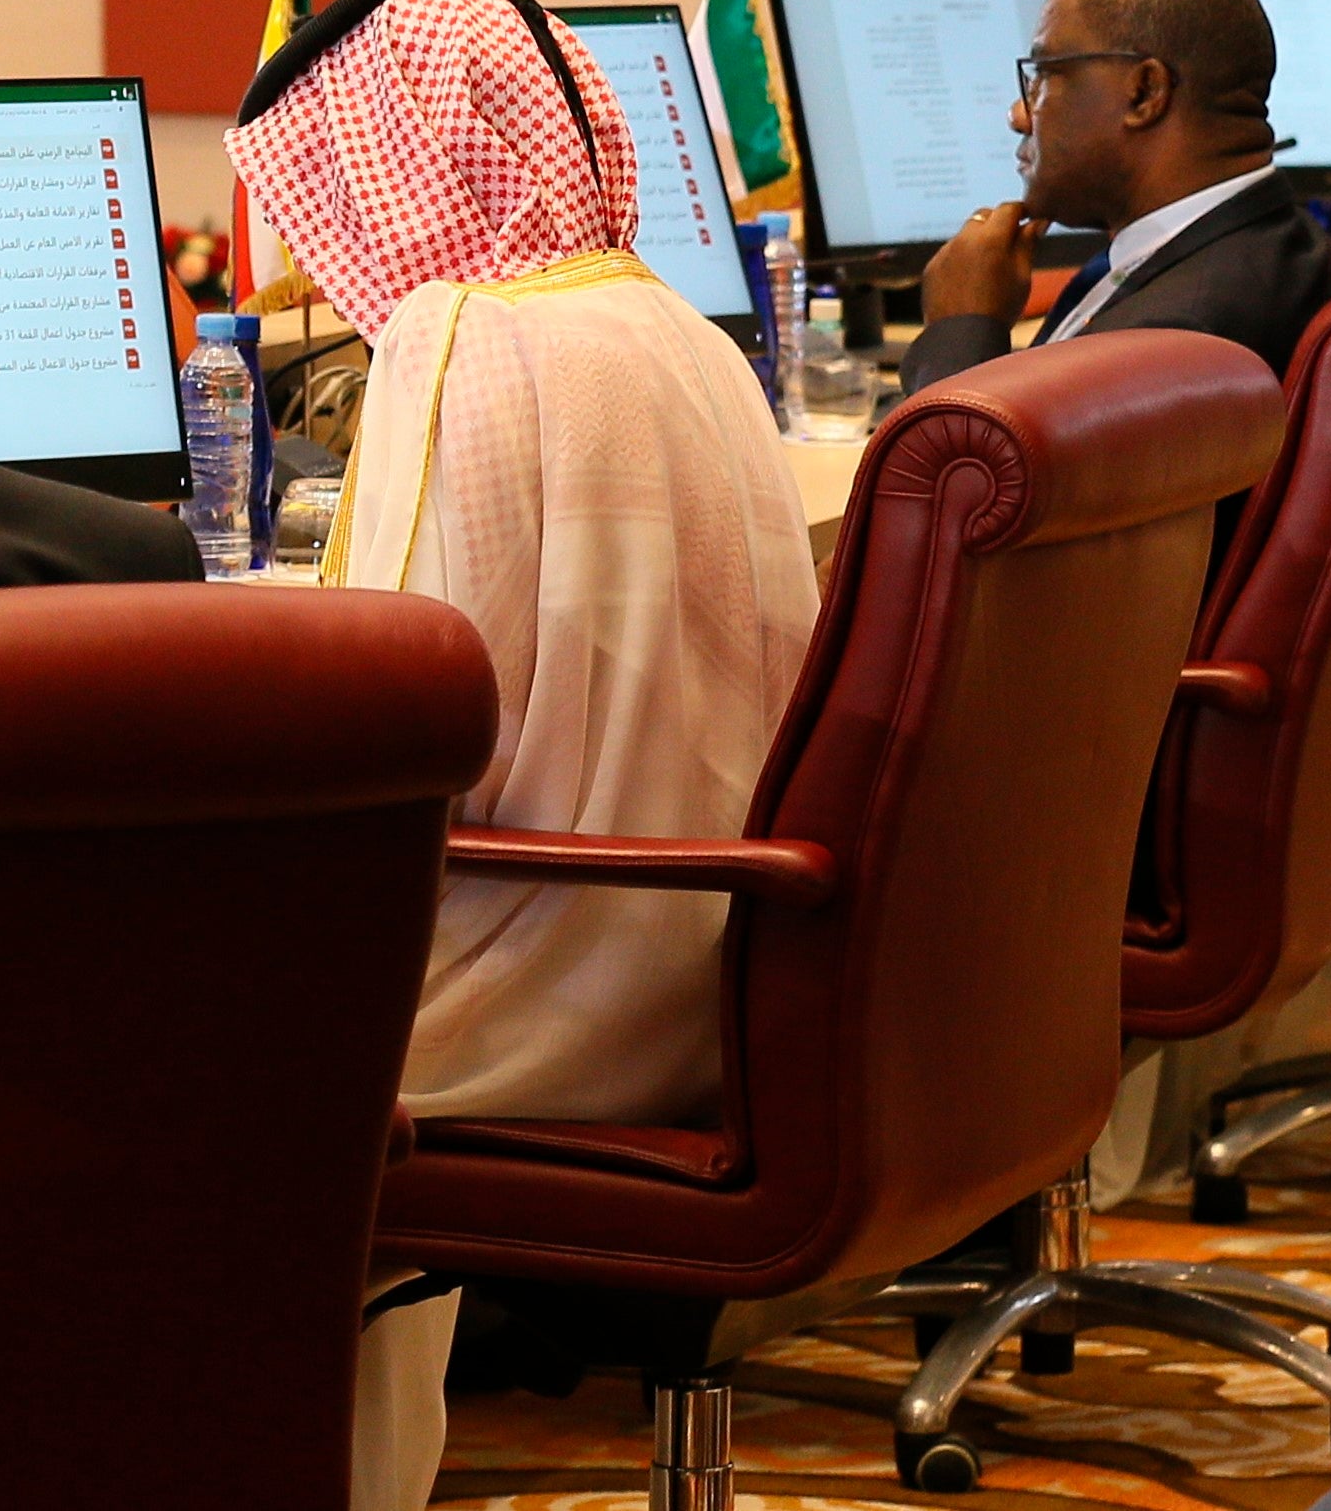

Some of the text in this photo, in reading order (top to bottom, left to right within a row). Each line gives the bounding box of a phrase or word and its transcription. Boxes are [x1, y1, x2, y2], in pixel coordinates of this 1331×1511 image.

[19, 147, 34, 159] على
[30, 176, 64, 190] ومشاريع
[66, 175, 96, 188] القرارات
[26, 207, 49, 218] العامة
[78, 206, 100, 220] تقارير
[0, 238, 20, 251] العمل
[23, 239, 35, 251] عن
[38, 237, 57, 248] العام
[85, 236, 104, 248] تقرير
[46, 267, 76, 280] القرارات
[0, 302, 10, 313] من
[50, 296, 79, 311] القرارات
[82, 298, 111, 310] مشاريع
[18, 329, 39, 340] القمة
[66, 327, 86, 340] جدول
[89, 327, 114, 340] مشروع
[19, 360, 35, 372] على
[69, 357, 90, 370] جدول
[92, 357, 118, 369] مشروع
